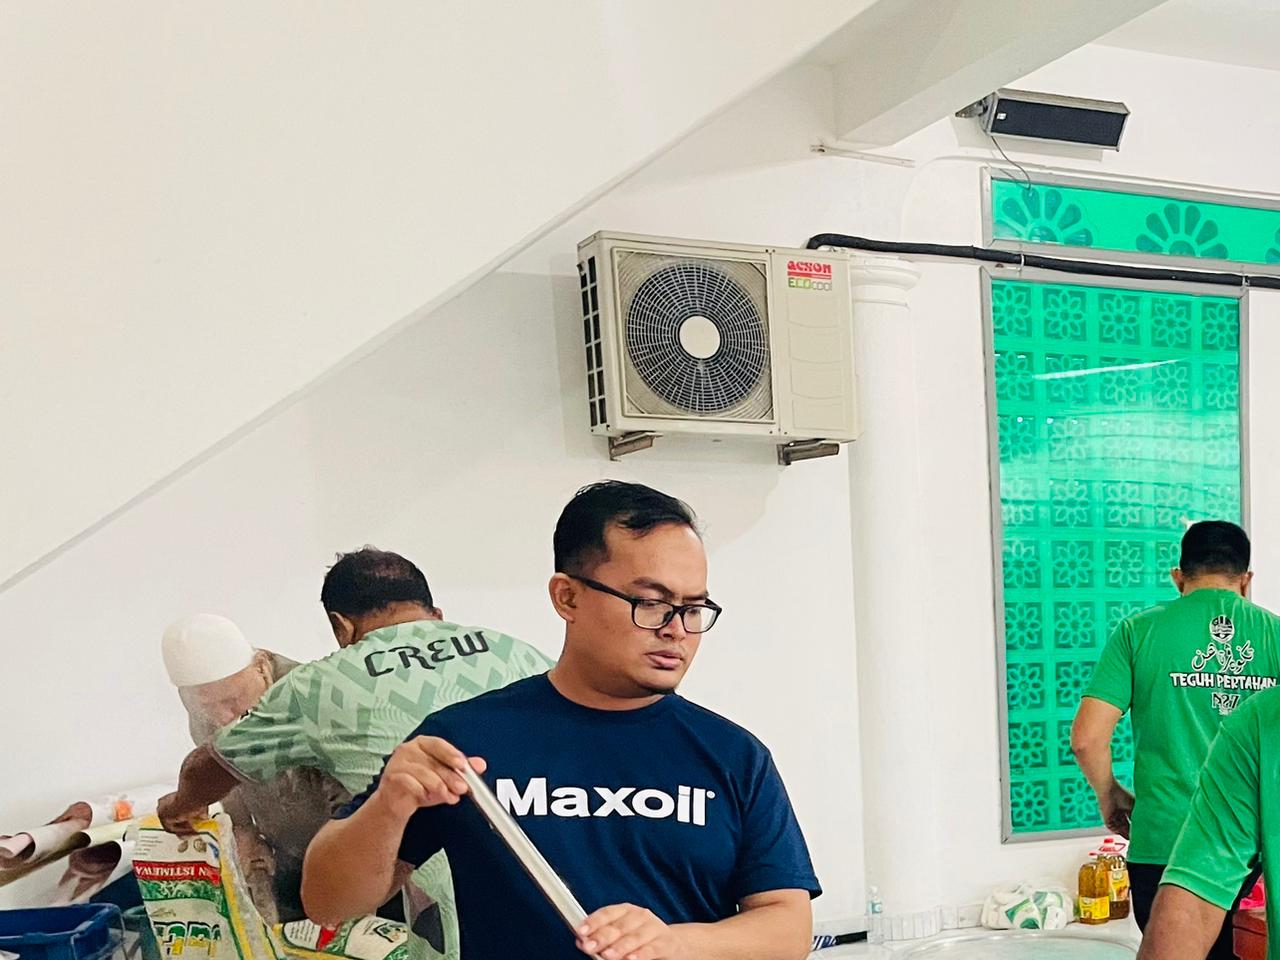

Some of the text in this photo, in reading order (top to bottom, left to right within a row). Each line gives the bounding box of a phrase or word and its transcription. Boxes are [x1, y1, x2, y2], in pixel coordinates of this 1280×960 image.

[364, 630, 490, 677] CREW
[1169, 672, 1277, 690] TEGUH PERTAHAN
[495, 777, 707, 826] Maxoil
[135, 864, 196, 878] ISTIMEWA
